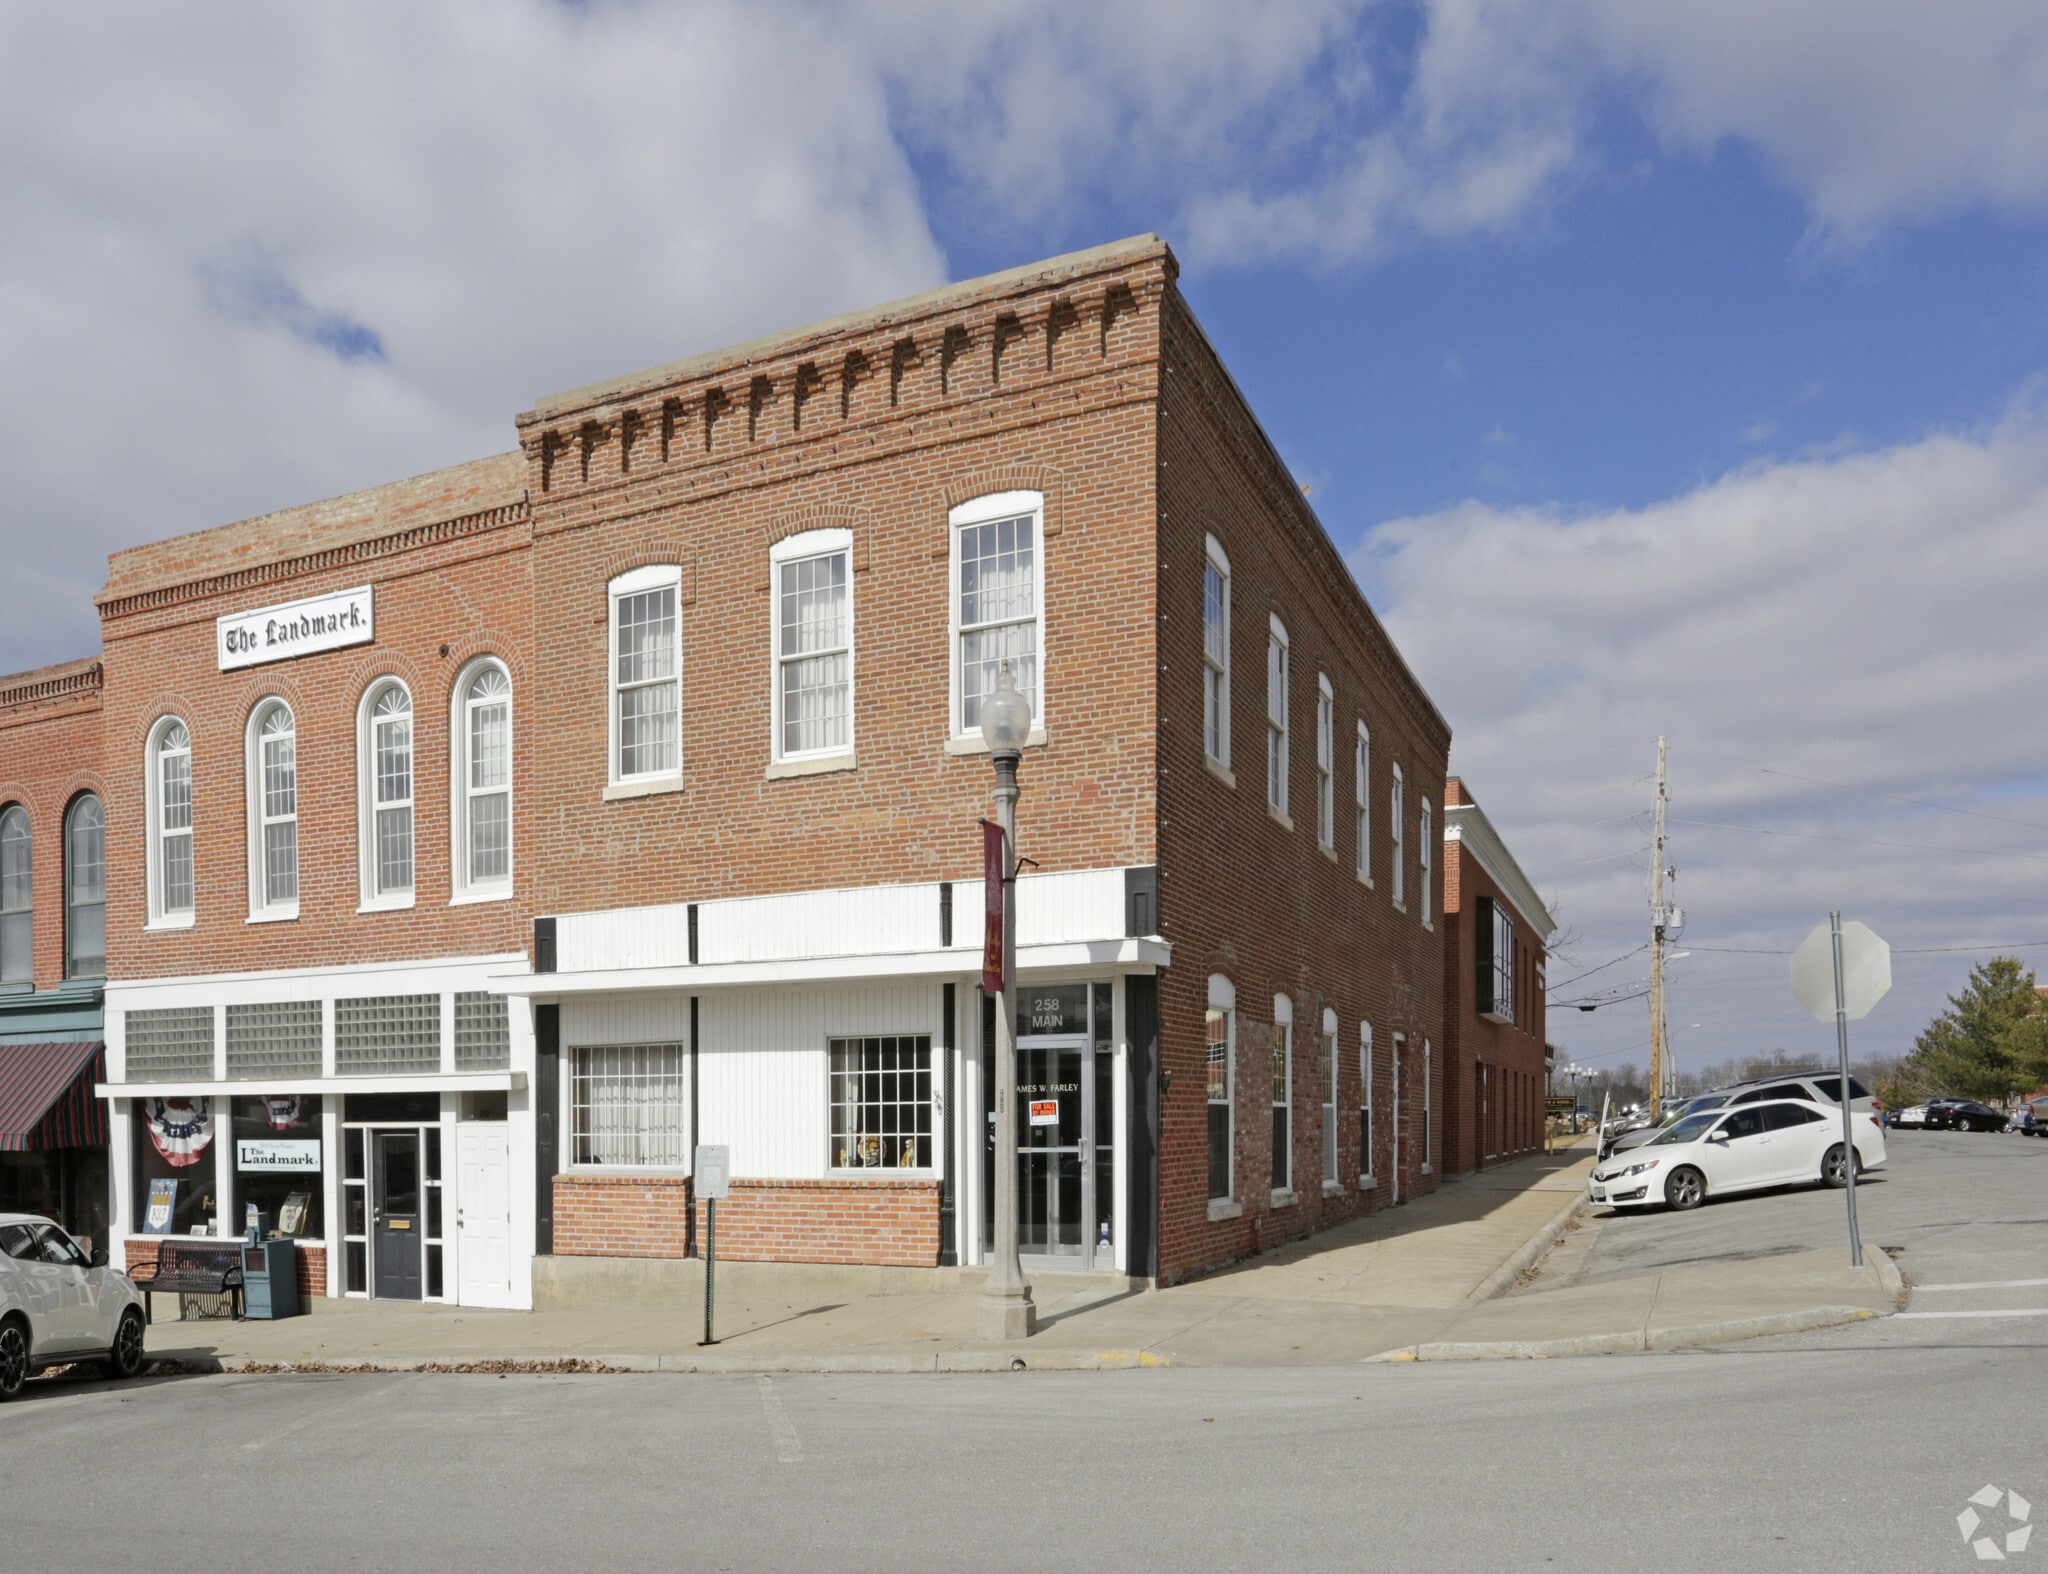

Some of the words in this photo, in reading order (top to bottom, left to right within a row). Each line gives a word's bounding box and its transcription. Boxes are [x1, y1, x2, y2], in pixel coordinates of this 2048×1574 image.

[226, 625, 258, 654] The
[1035, 998, 1060, 1011] 258
[1032, 1014, 1063, 1028] MAIN
[1016, 1084, 1037, 1093] AMES
[1050, 1083, 1079, 1092] FARLEY
[1032, 1102, 1042, 1110] FOR
[1043, 1101, 1056, 1110] SALE
[250, 1147, 264, 1155] The
[151, 1207, 168, 1221] KC
